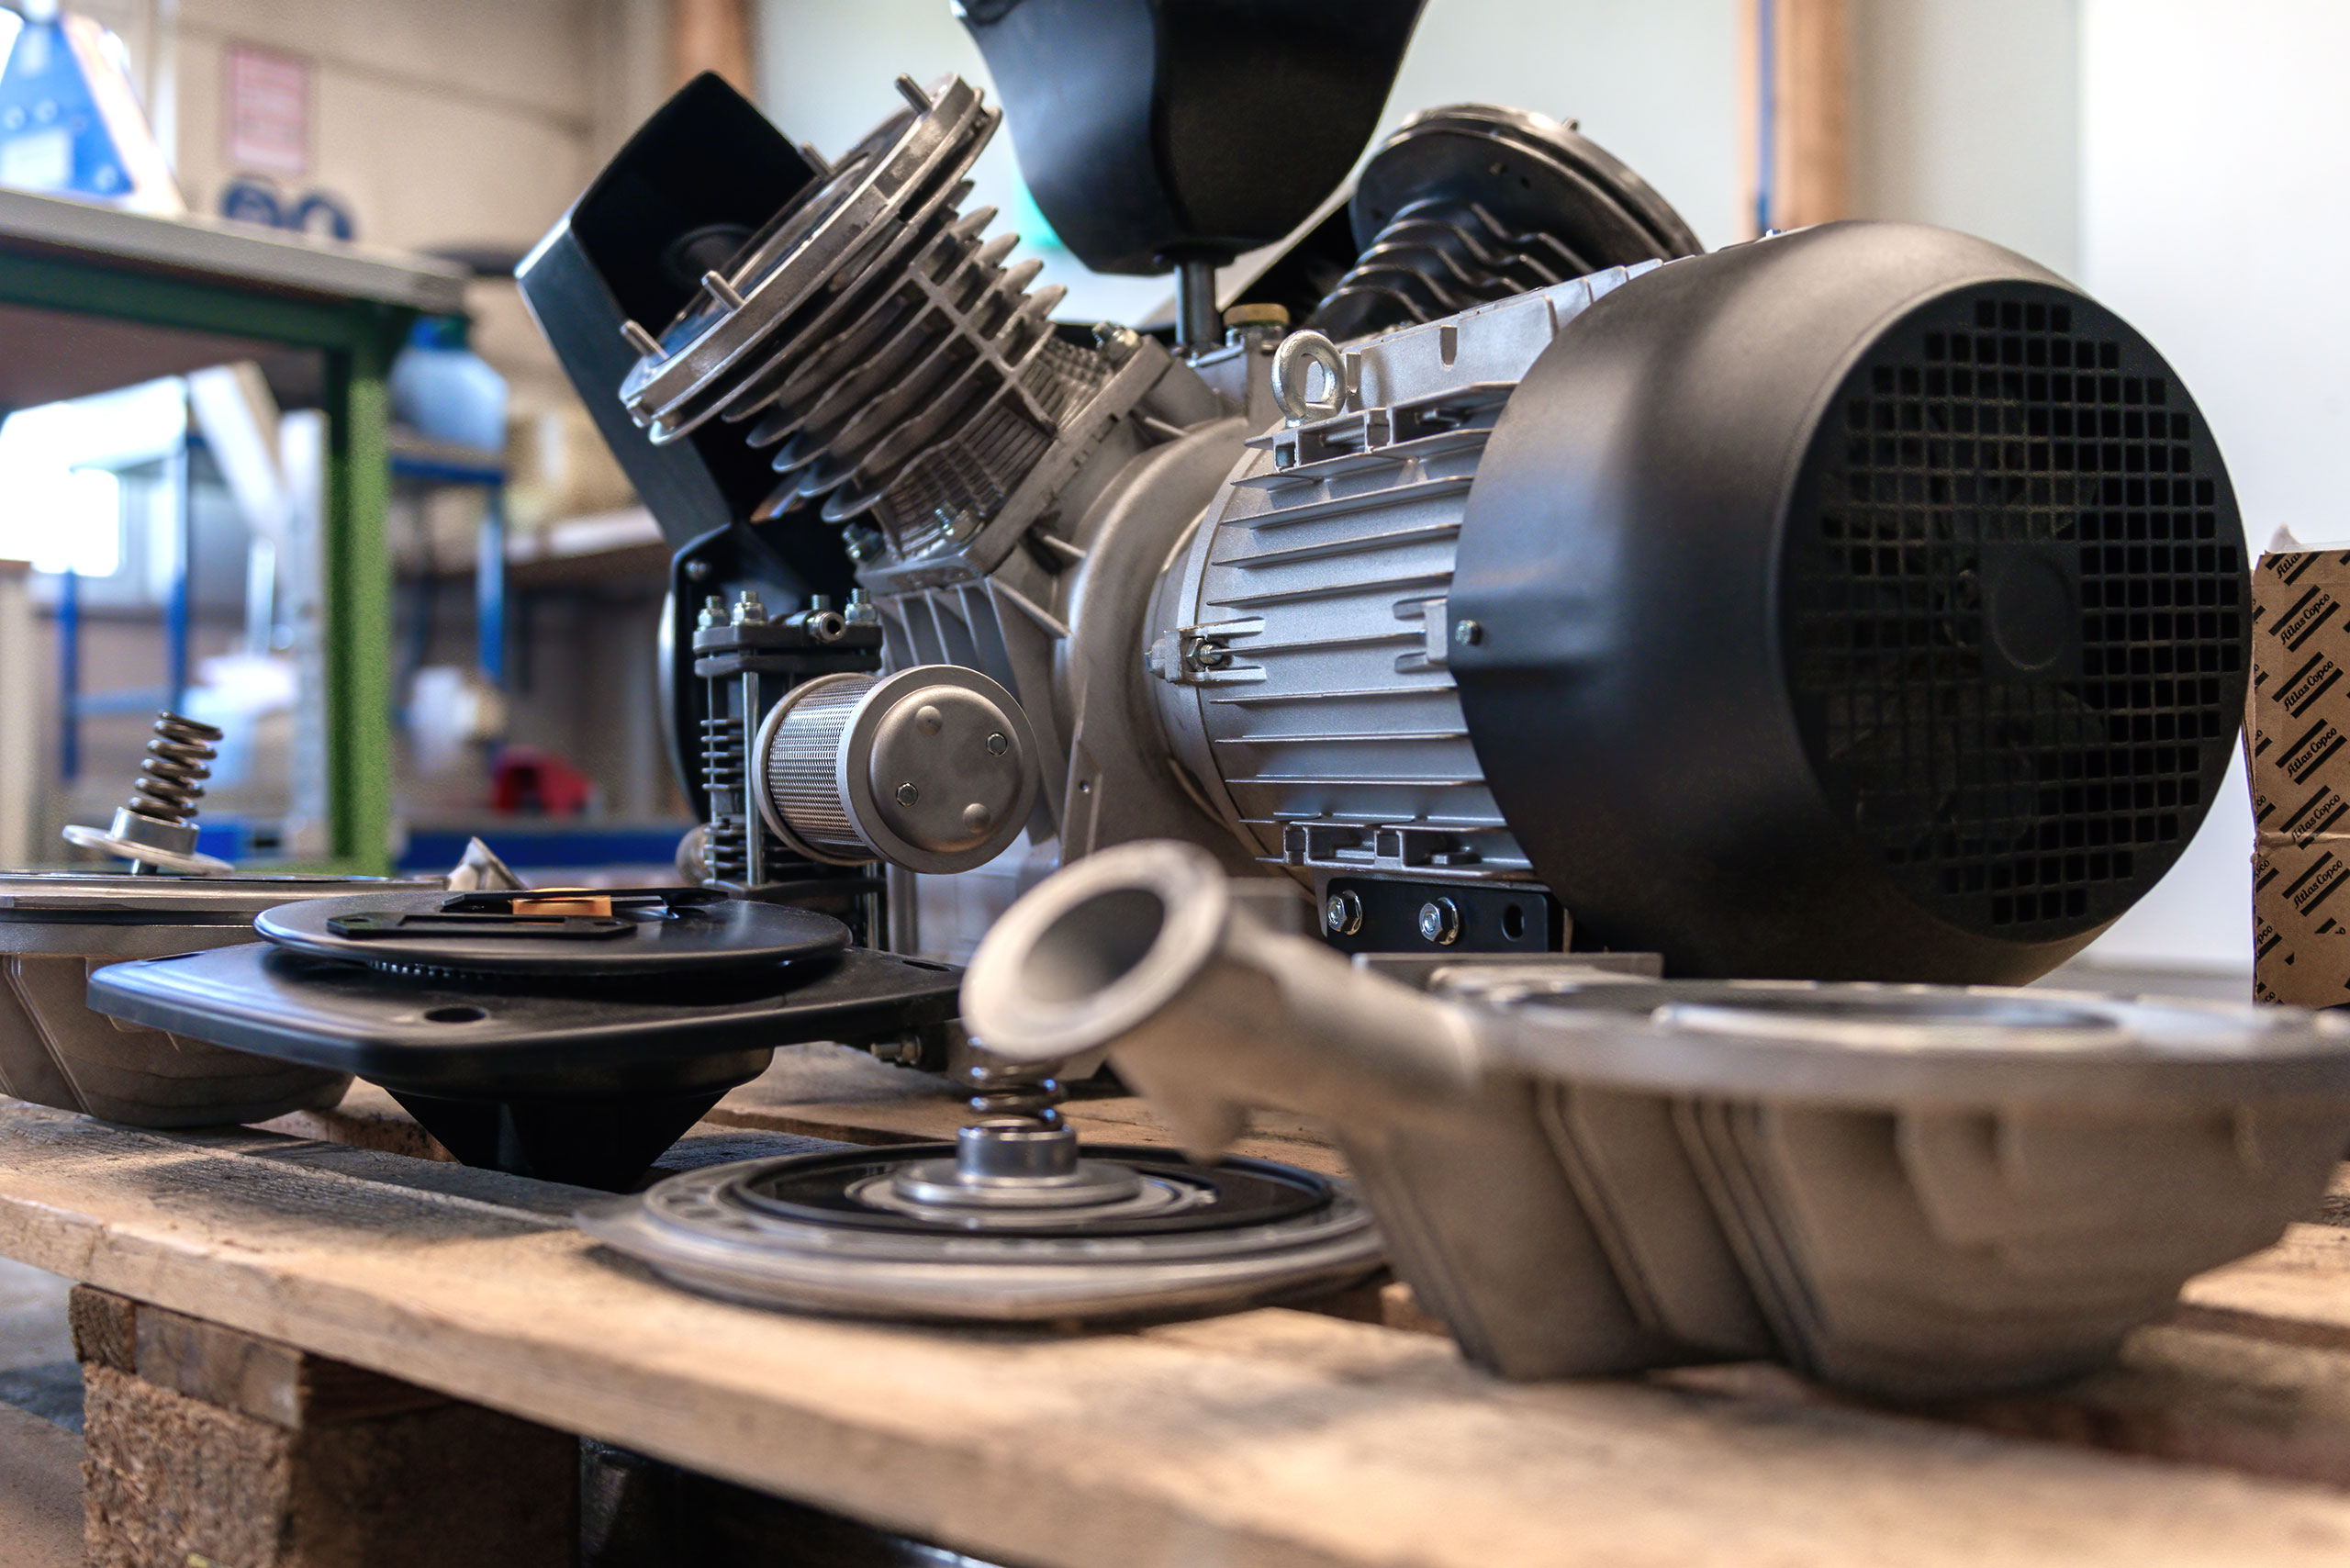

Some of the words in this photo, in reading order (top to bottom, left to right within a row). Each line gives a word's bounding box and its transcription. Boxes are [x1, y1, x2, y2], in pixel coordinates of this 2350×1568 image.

[2277, 553, 2302, 578] Atlas
[2280, 618, 2306, 644] Atlas
[2303, 593, 2330, 620] Copco
[2284, 684, 2310, 711] Atlas
[2307, 660, 2333, 686] Copco
[2288, 751, 2312, 778] Atlas
[2311, 728, 2337, 753] Copco
[2291, 819, 2316, 843] Atlas
[2313, 794, 2340, 819] Copco
[2294, 884, 2319, 909] Atlas
[2316, 860, 2343, 884] Copco
